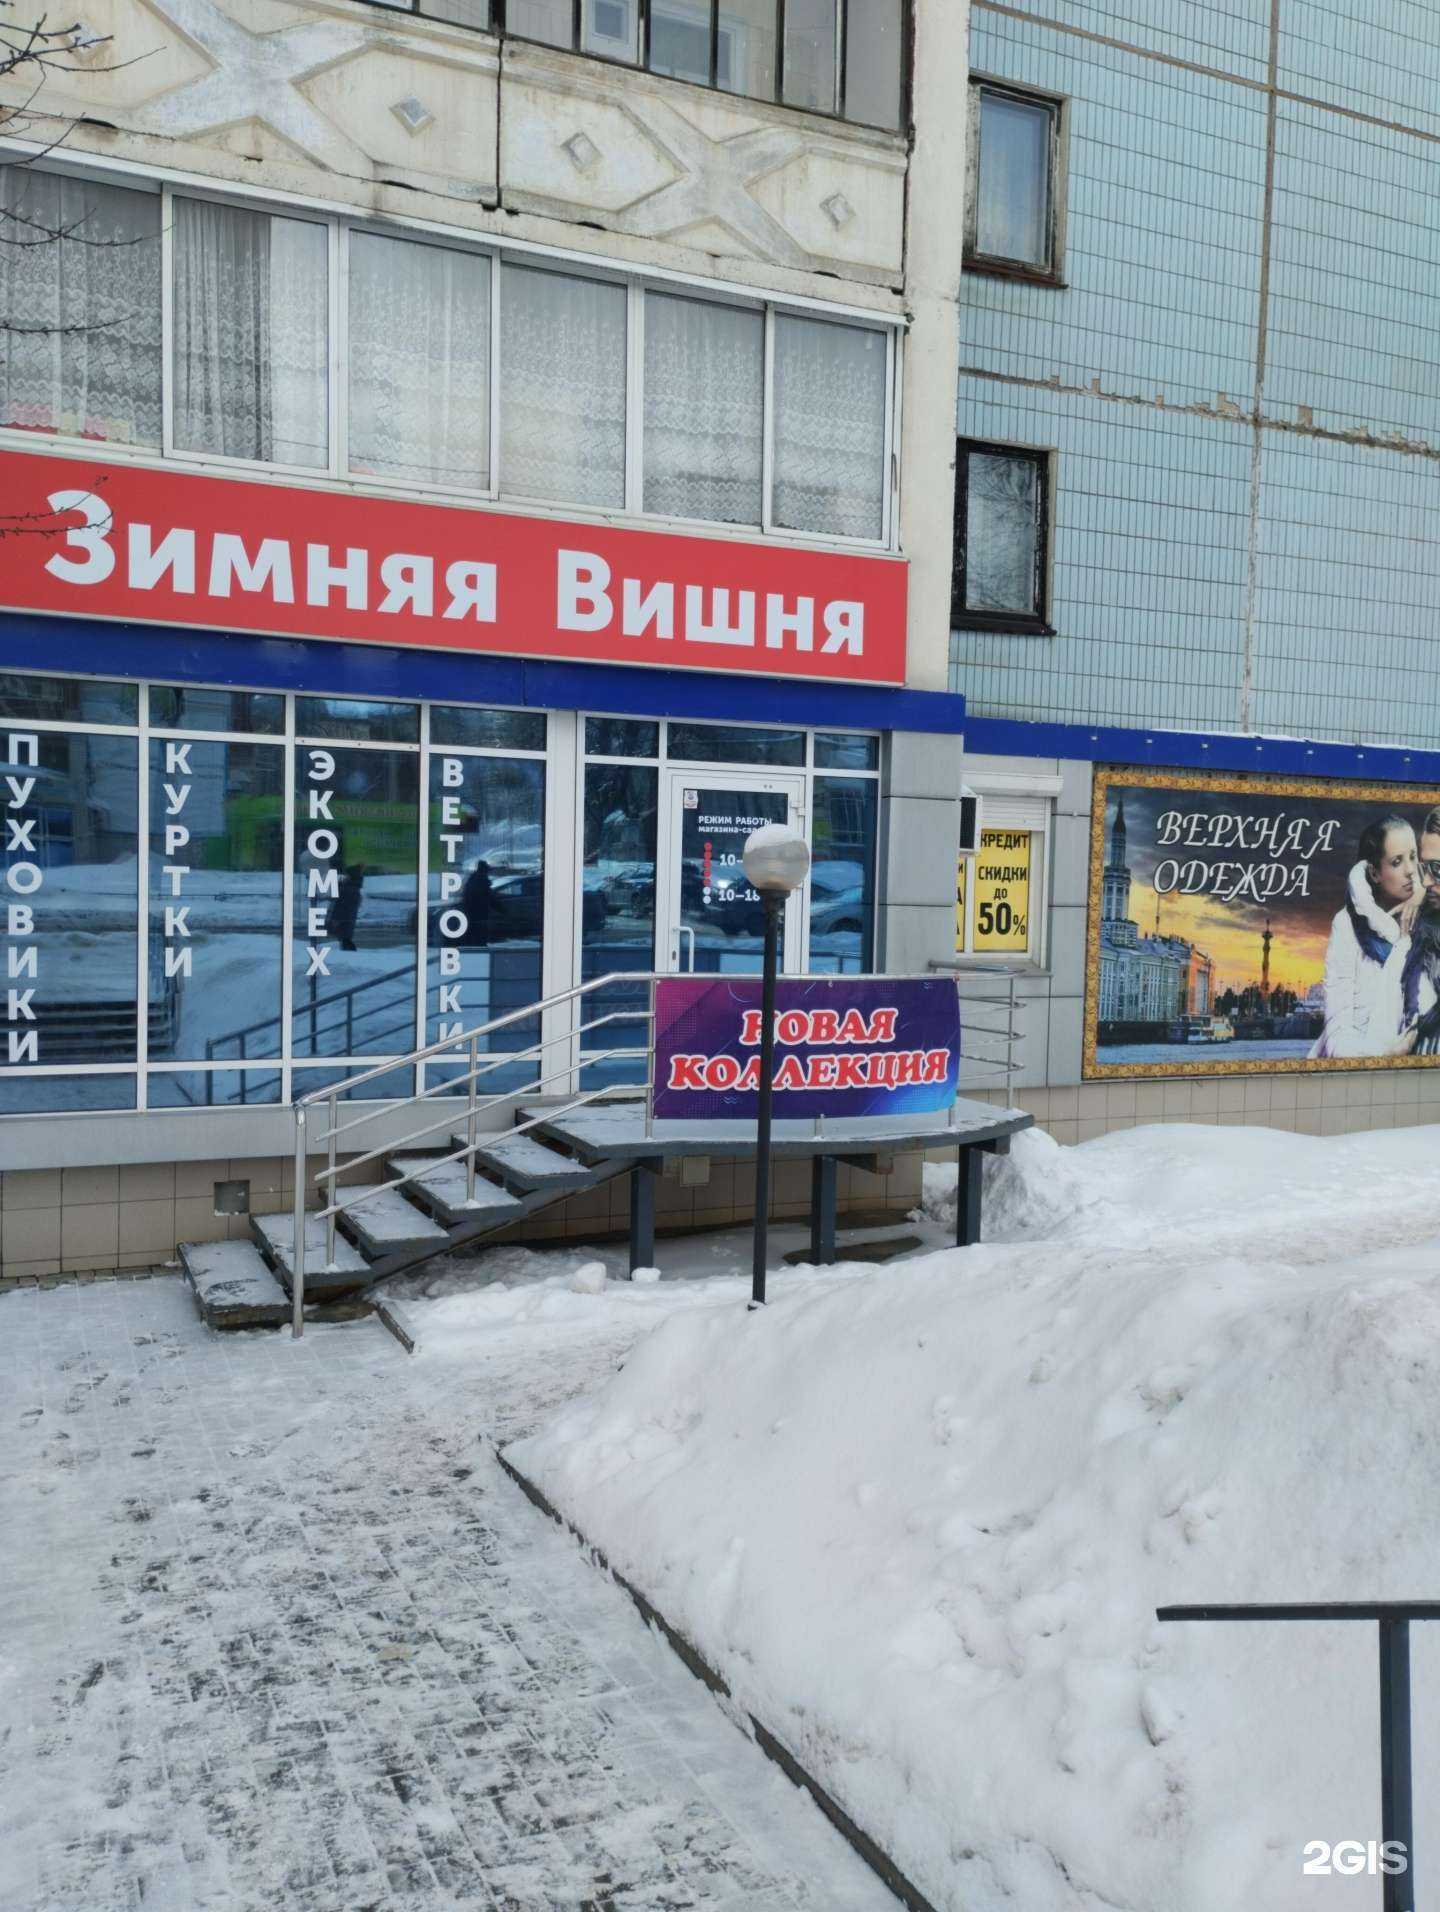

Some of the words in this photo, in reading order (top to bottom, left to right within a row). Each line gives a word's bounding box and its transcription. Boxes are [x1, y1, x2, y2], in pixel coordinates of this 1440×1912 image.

[44, 489, 497, 623] Зимняя
[557, 549, 865, 655] Вишня
[698, 815, 732, 825] РЕЖИМ
[735, 817, 772, 825] РАБОТЫ
[980, 833, 1028, 850] КРЕДИТ
[1156, 811, 1341, 859] ВЕРХНЯЯ
[164, 743, 192, 978] КУРТКИ
[306, 750, 340, 976] ЭКОМЕХ
[978, 866, 1027, 882] СКИДКИ
[1153, 859, 1311, 902] ОДЕЖДА
[6, 734, 43, 1062] ПУХОВИКИ
[439, 758, 468, 1049] ВЕТРОВКИ
[993, 888, 1008, 901] ДО
[977, 902, 1025, 936] 50%
